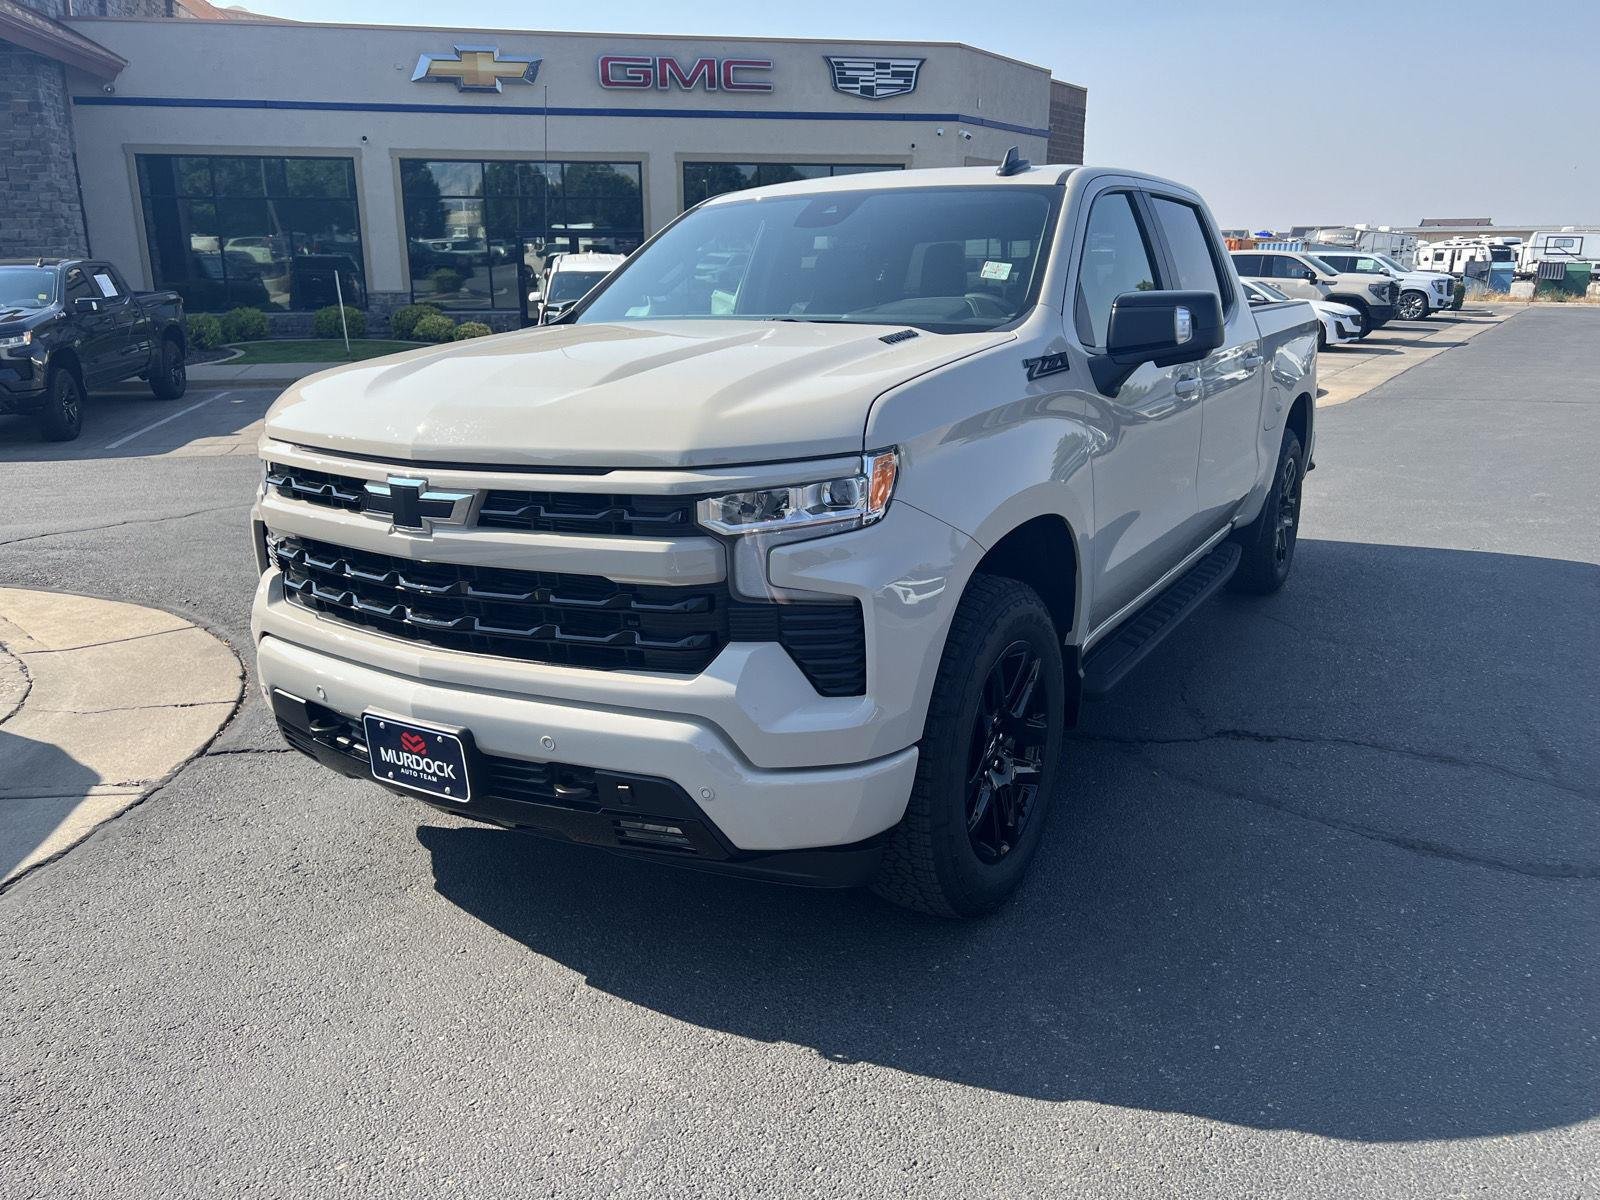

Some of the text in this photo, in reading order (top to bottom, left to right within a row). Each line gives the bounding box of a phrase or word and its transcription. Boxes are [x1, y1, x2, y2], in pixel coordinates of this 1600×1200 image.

[598, 55, 774, 92] GMC
[379, 746, 457, 780] MURDOCK
[400, 768, 438, 783] AUTO TEAM
